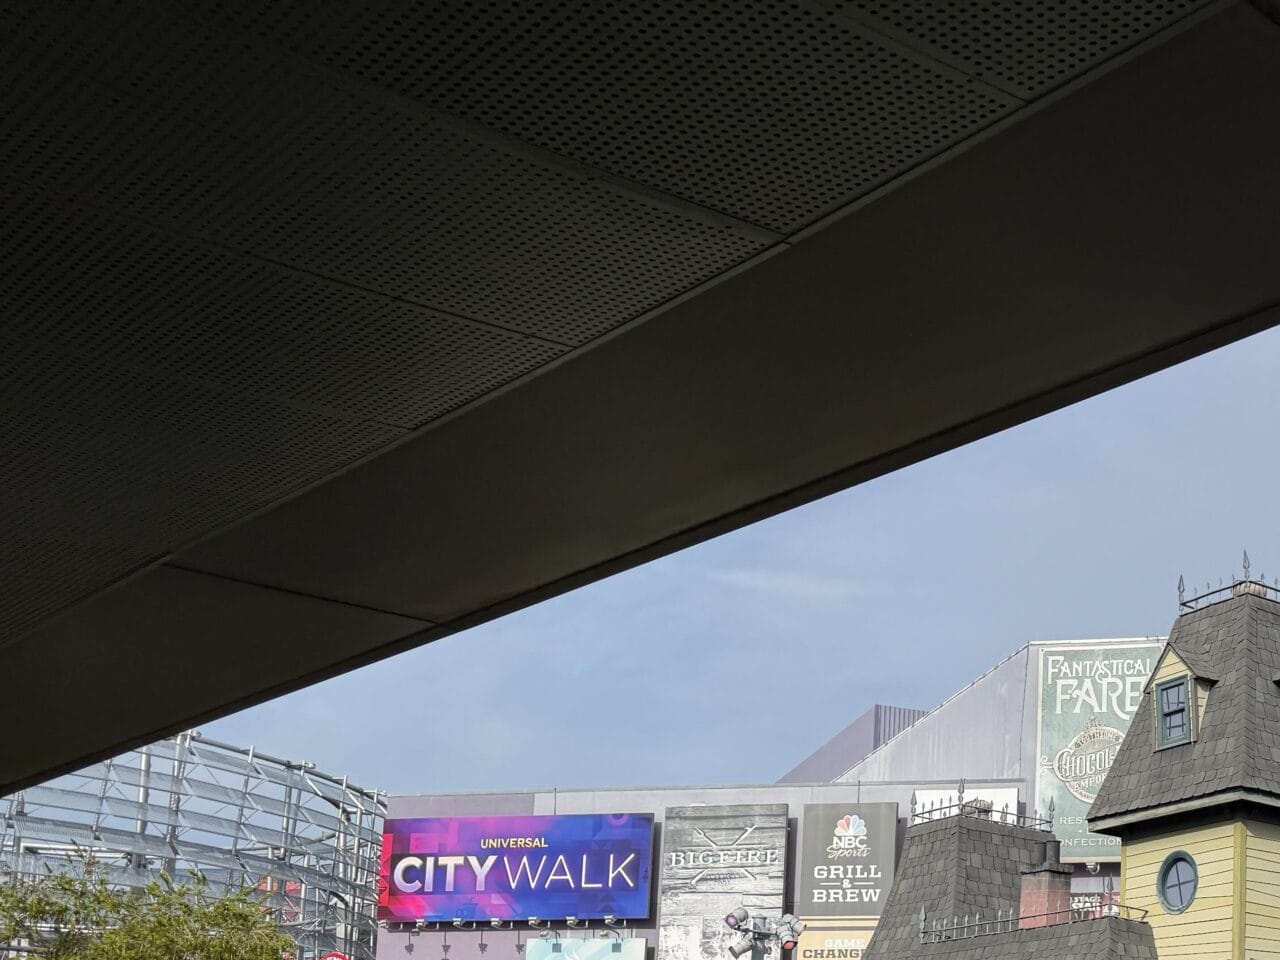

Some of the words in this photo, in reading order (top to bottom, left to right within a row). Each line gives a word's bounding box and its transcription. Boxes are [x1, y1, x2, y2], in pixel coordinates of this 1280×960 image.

[1047, 655, 1151, 685] FANTASTICAL
[1055, 676, 1149, 720] FARE
[481, 837, 549, 849] UNIVERSAL
[833, 836, 867, 849] NBC
[1059, 838, 1121, 847] ONFECTION
[826, 845, 871, 860] Sports
[813, 865, 882, 879] GRILL
[842, 879, 852, 888] &
[811, 889, 882, 903] BREW
[824, 938, 865, 948] GAME
